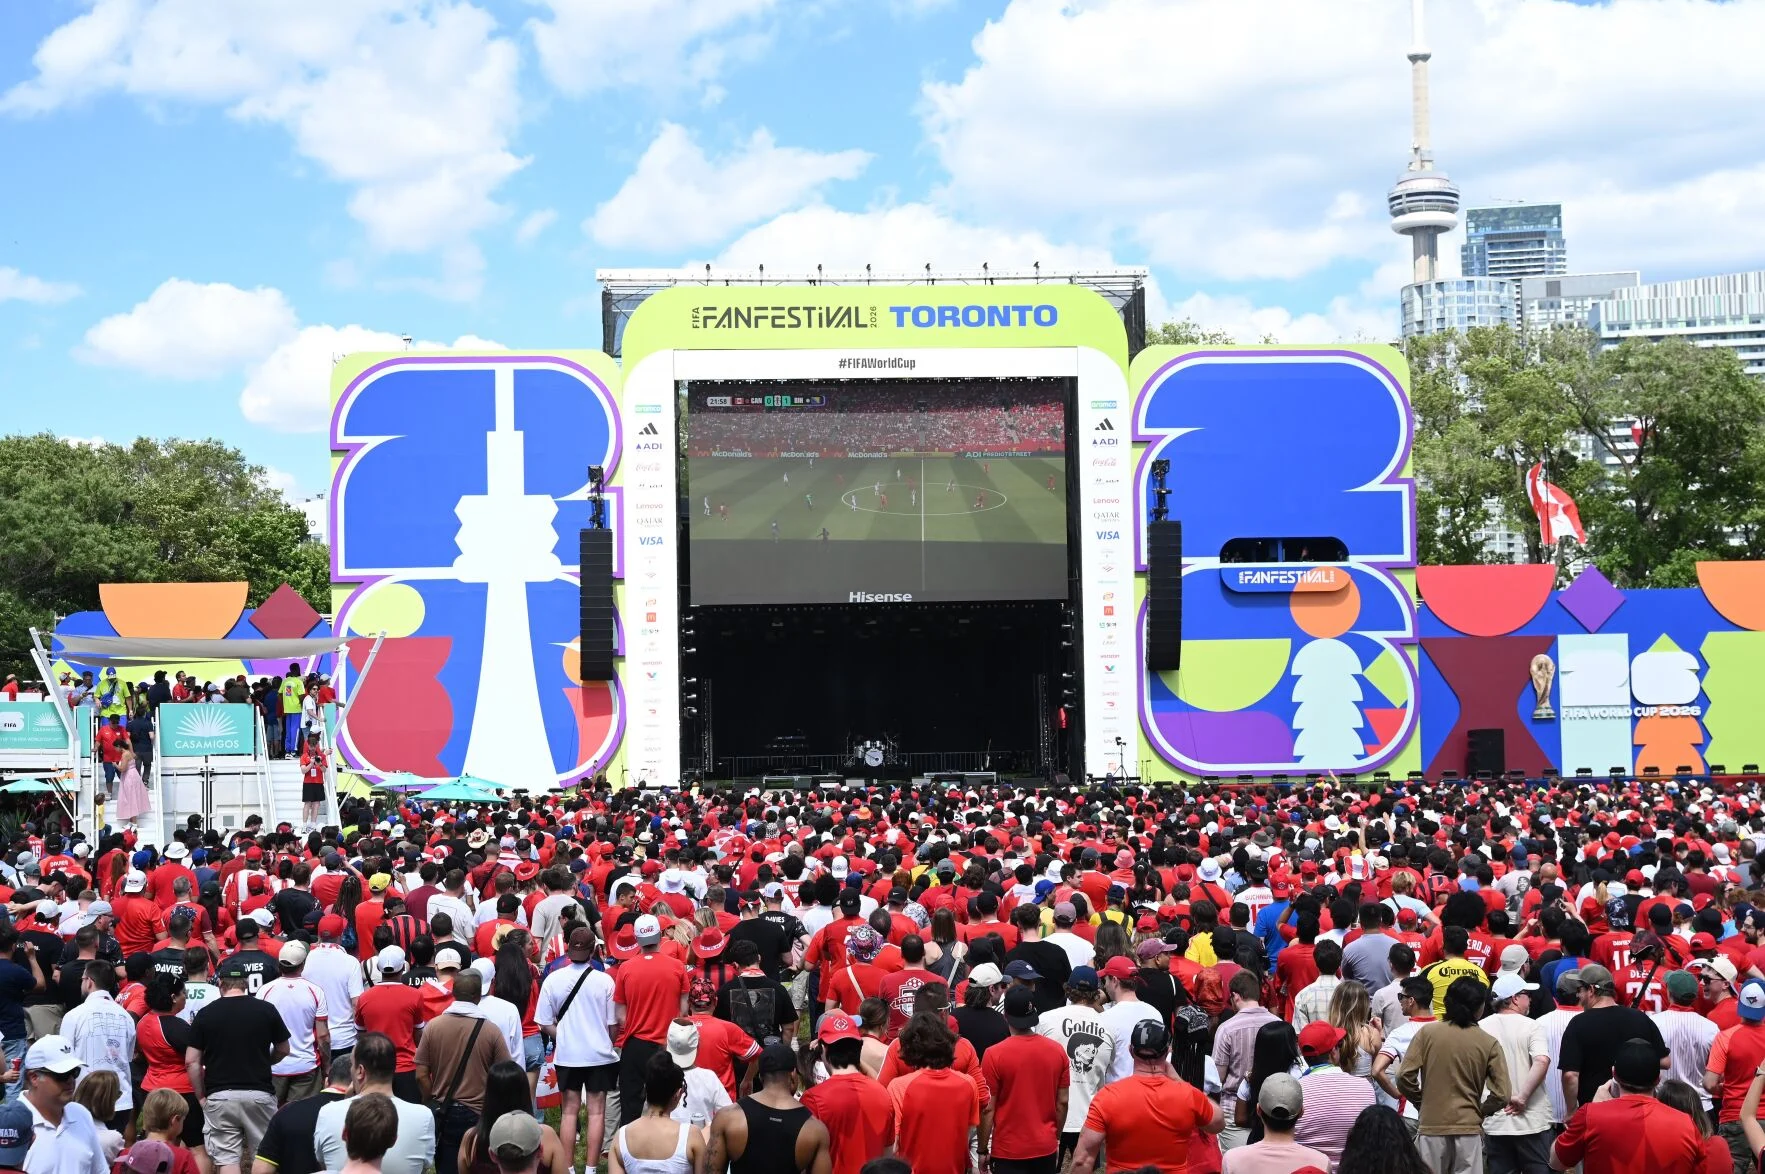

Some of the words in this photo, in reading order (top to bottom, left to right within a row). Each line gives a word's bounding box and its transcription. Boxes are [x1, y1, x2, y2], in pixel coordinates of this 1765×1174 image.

[692, 307, 700, 329] FIFA
[870, 306, 878, 328] 2026
[889, 304, 1058, 328] TORONTO
[838, 357, 916, 370] #FIFAWorldCup
[766, 397, 772, 405] 0
[1093, 512, 1120, 520] QATAR
[639, 536, 663, 545] VISA
[1096, 531, 1120, 540] VISA
[849, 591, 912, 602] Hisense
[1562, 707, 1588, 719] FIFA
[1590, 707, 1632, 719] WORLD
[1634, 707, 1657, 717] CUP
[1659, 705, 1701, 717] 2026
[174, 739, 240, 749] CASAMIGOS
[1467, 939, 1481, 950] ERO
[154, 963, 184, 974] DAVIES
[1438, 966, 1480, 979] Corona
[1062, 1018, 1106, 1039] Goldie
